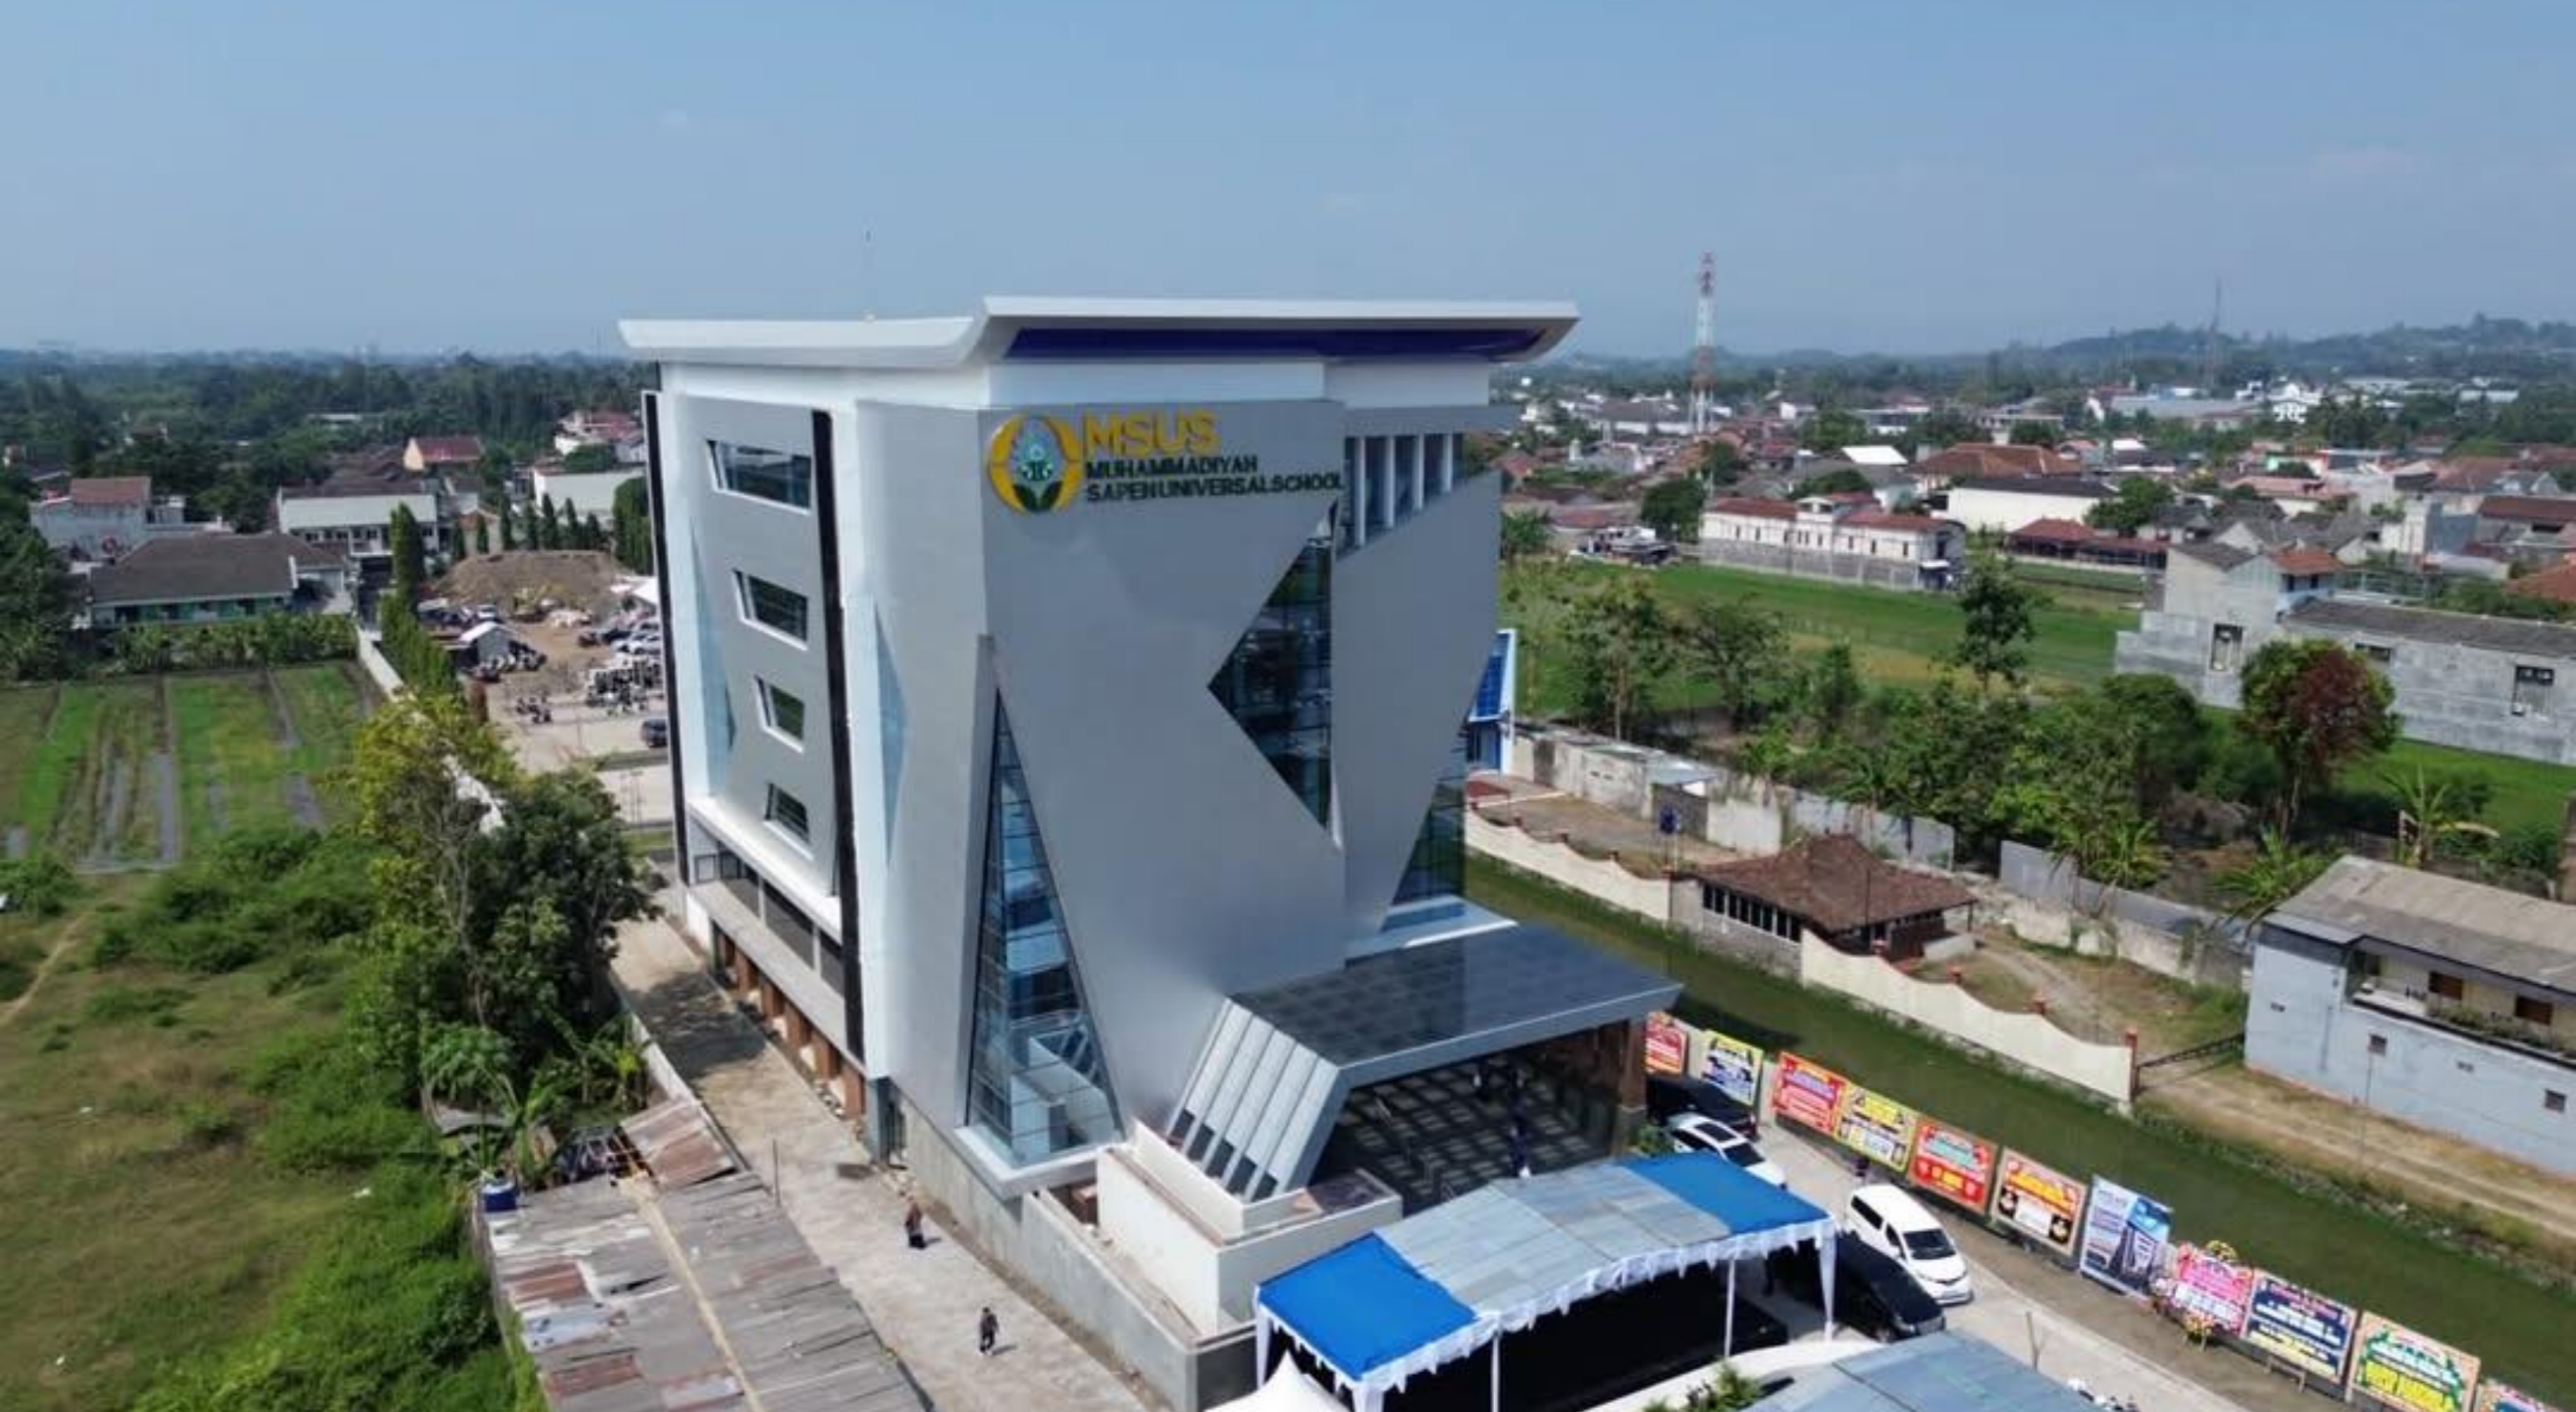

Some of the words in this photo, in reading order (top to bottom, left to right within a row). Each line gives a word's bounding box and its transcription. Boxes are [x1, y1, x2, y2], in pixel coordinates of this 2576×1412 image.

[1085, 410, 1221, 457] MSUS
[1086, 455, 1259, 478] MUHAMMADIYAH
[1087, 481, 1156, 501] SAPEN
[1159, 476, 1272, 498] UNIVERSAL
[1273, 472, 1345, 493] SCHOOL
